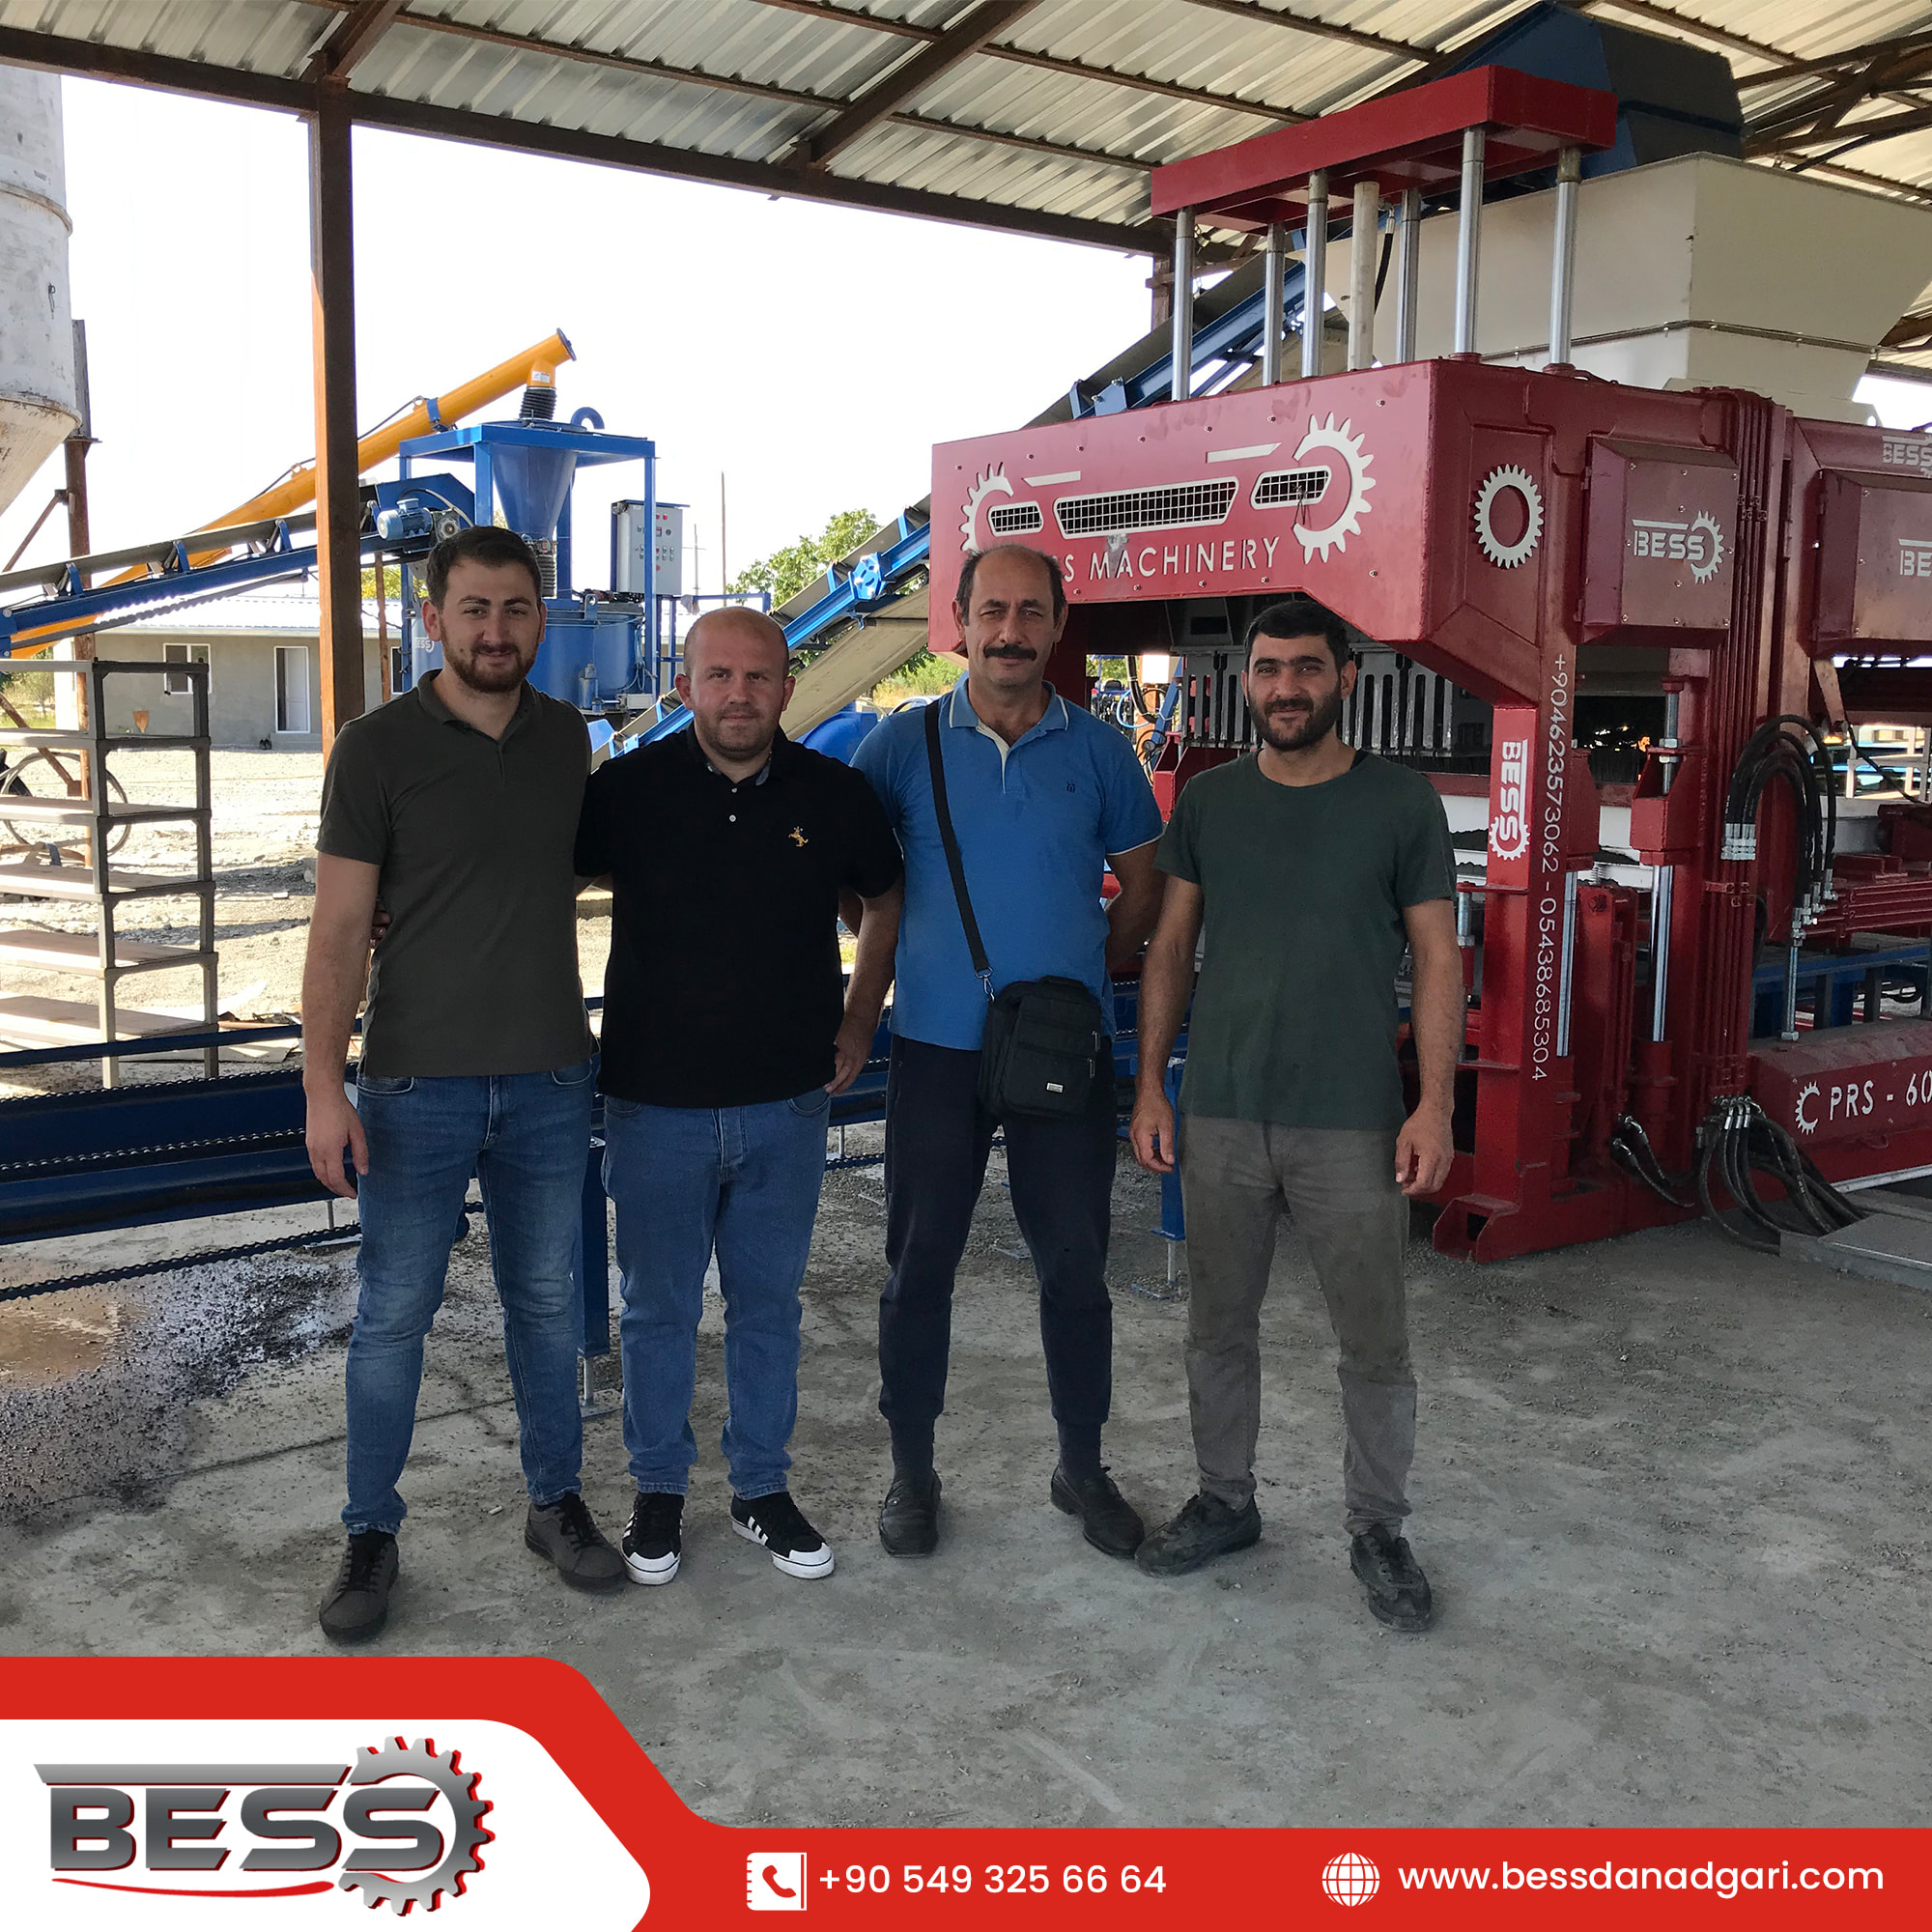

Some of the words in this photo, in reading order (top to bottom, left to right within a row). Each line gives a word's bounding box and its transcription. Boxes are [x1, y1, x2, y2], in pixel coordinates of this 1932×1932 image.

[1883, 443, 1932, 467] BESS
[1090, 537, 1279, 581] MACHINERY
[1634, 530, 1705, 560] BESS
[1899, 550, 1932, 577] BE
[1543, 653, 1568, 873] +904623573062
[1499, 741, 1522, 841] BESS
[1531, 897, 1557, 1080] 05438685304
[1830, 1079, 1874, 1121] PRS
